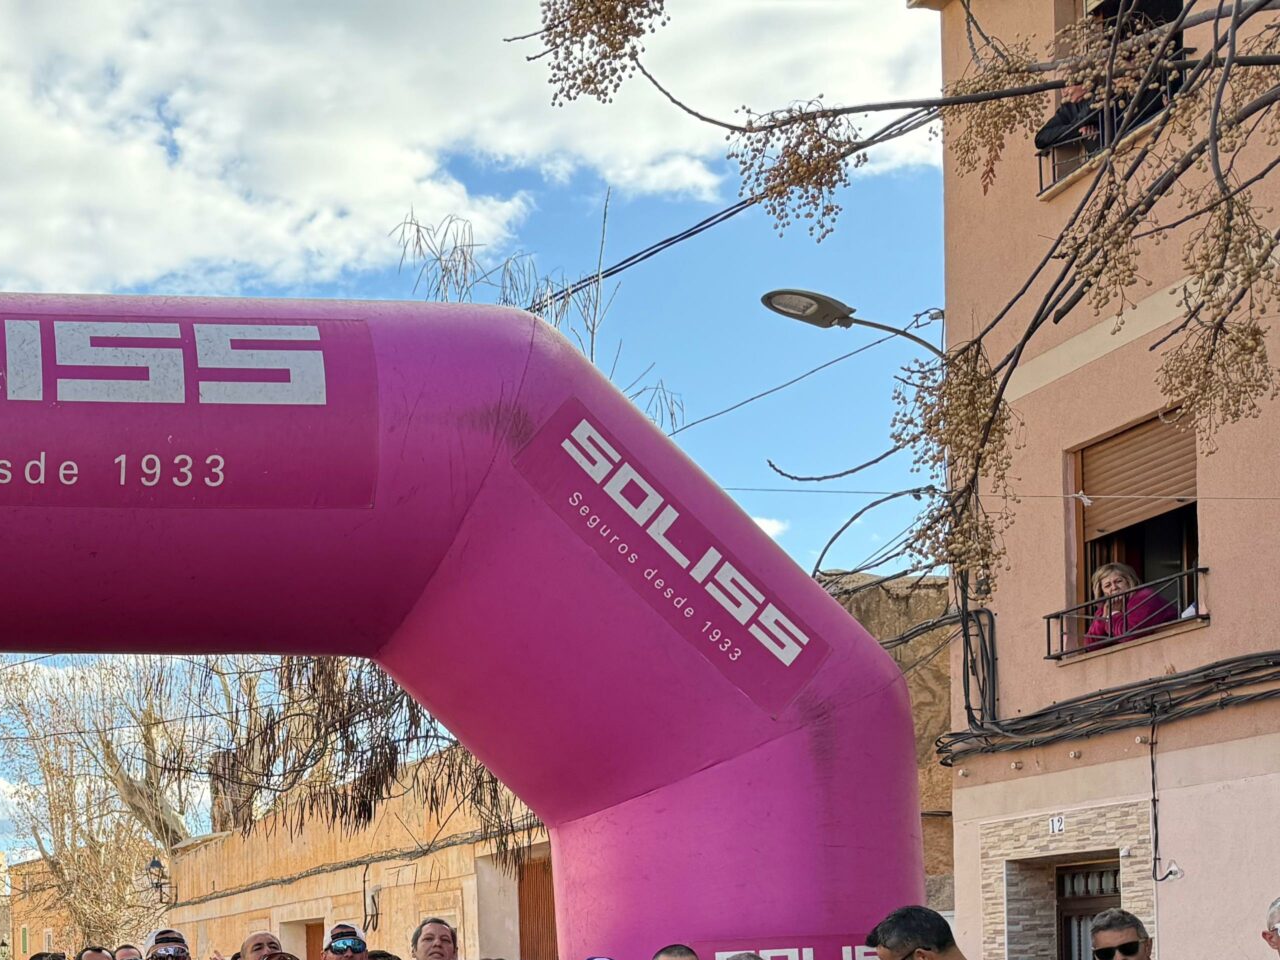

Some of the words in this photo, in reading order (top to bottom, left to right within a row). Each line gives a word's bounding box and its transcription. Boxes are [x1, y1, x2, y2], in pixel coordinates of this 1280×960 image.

[114, 453, 225, 487] 1933
[561, 419, 810, 667] SOLISS
[568, 491, 638, 564] Seguros
[643, 567, 694, 618] desde
[700, 620, 742, 661] 1933
[1050, 816, 1063, 834] 12
